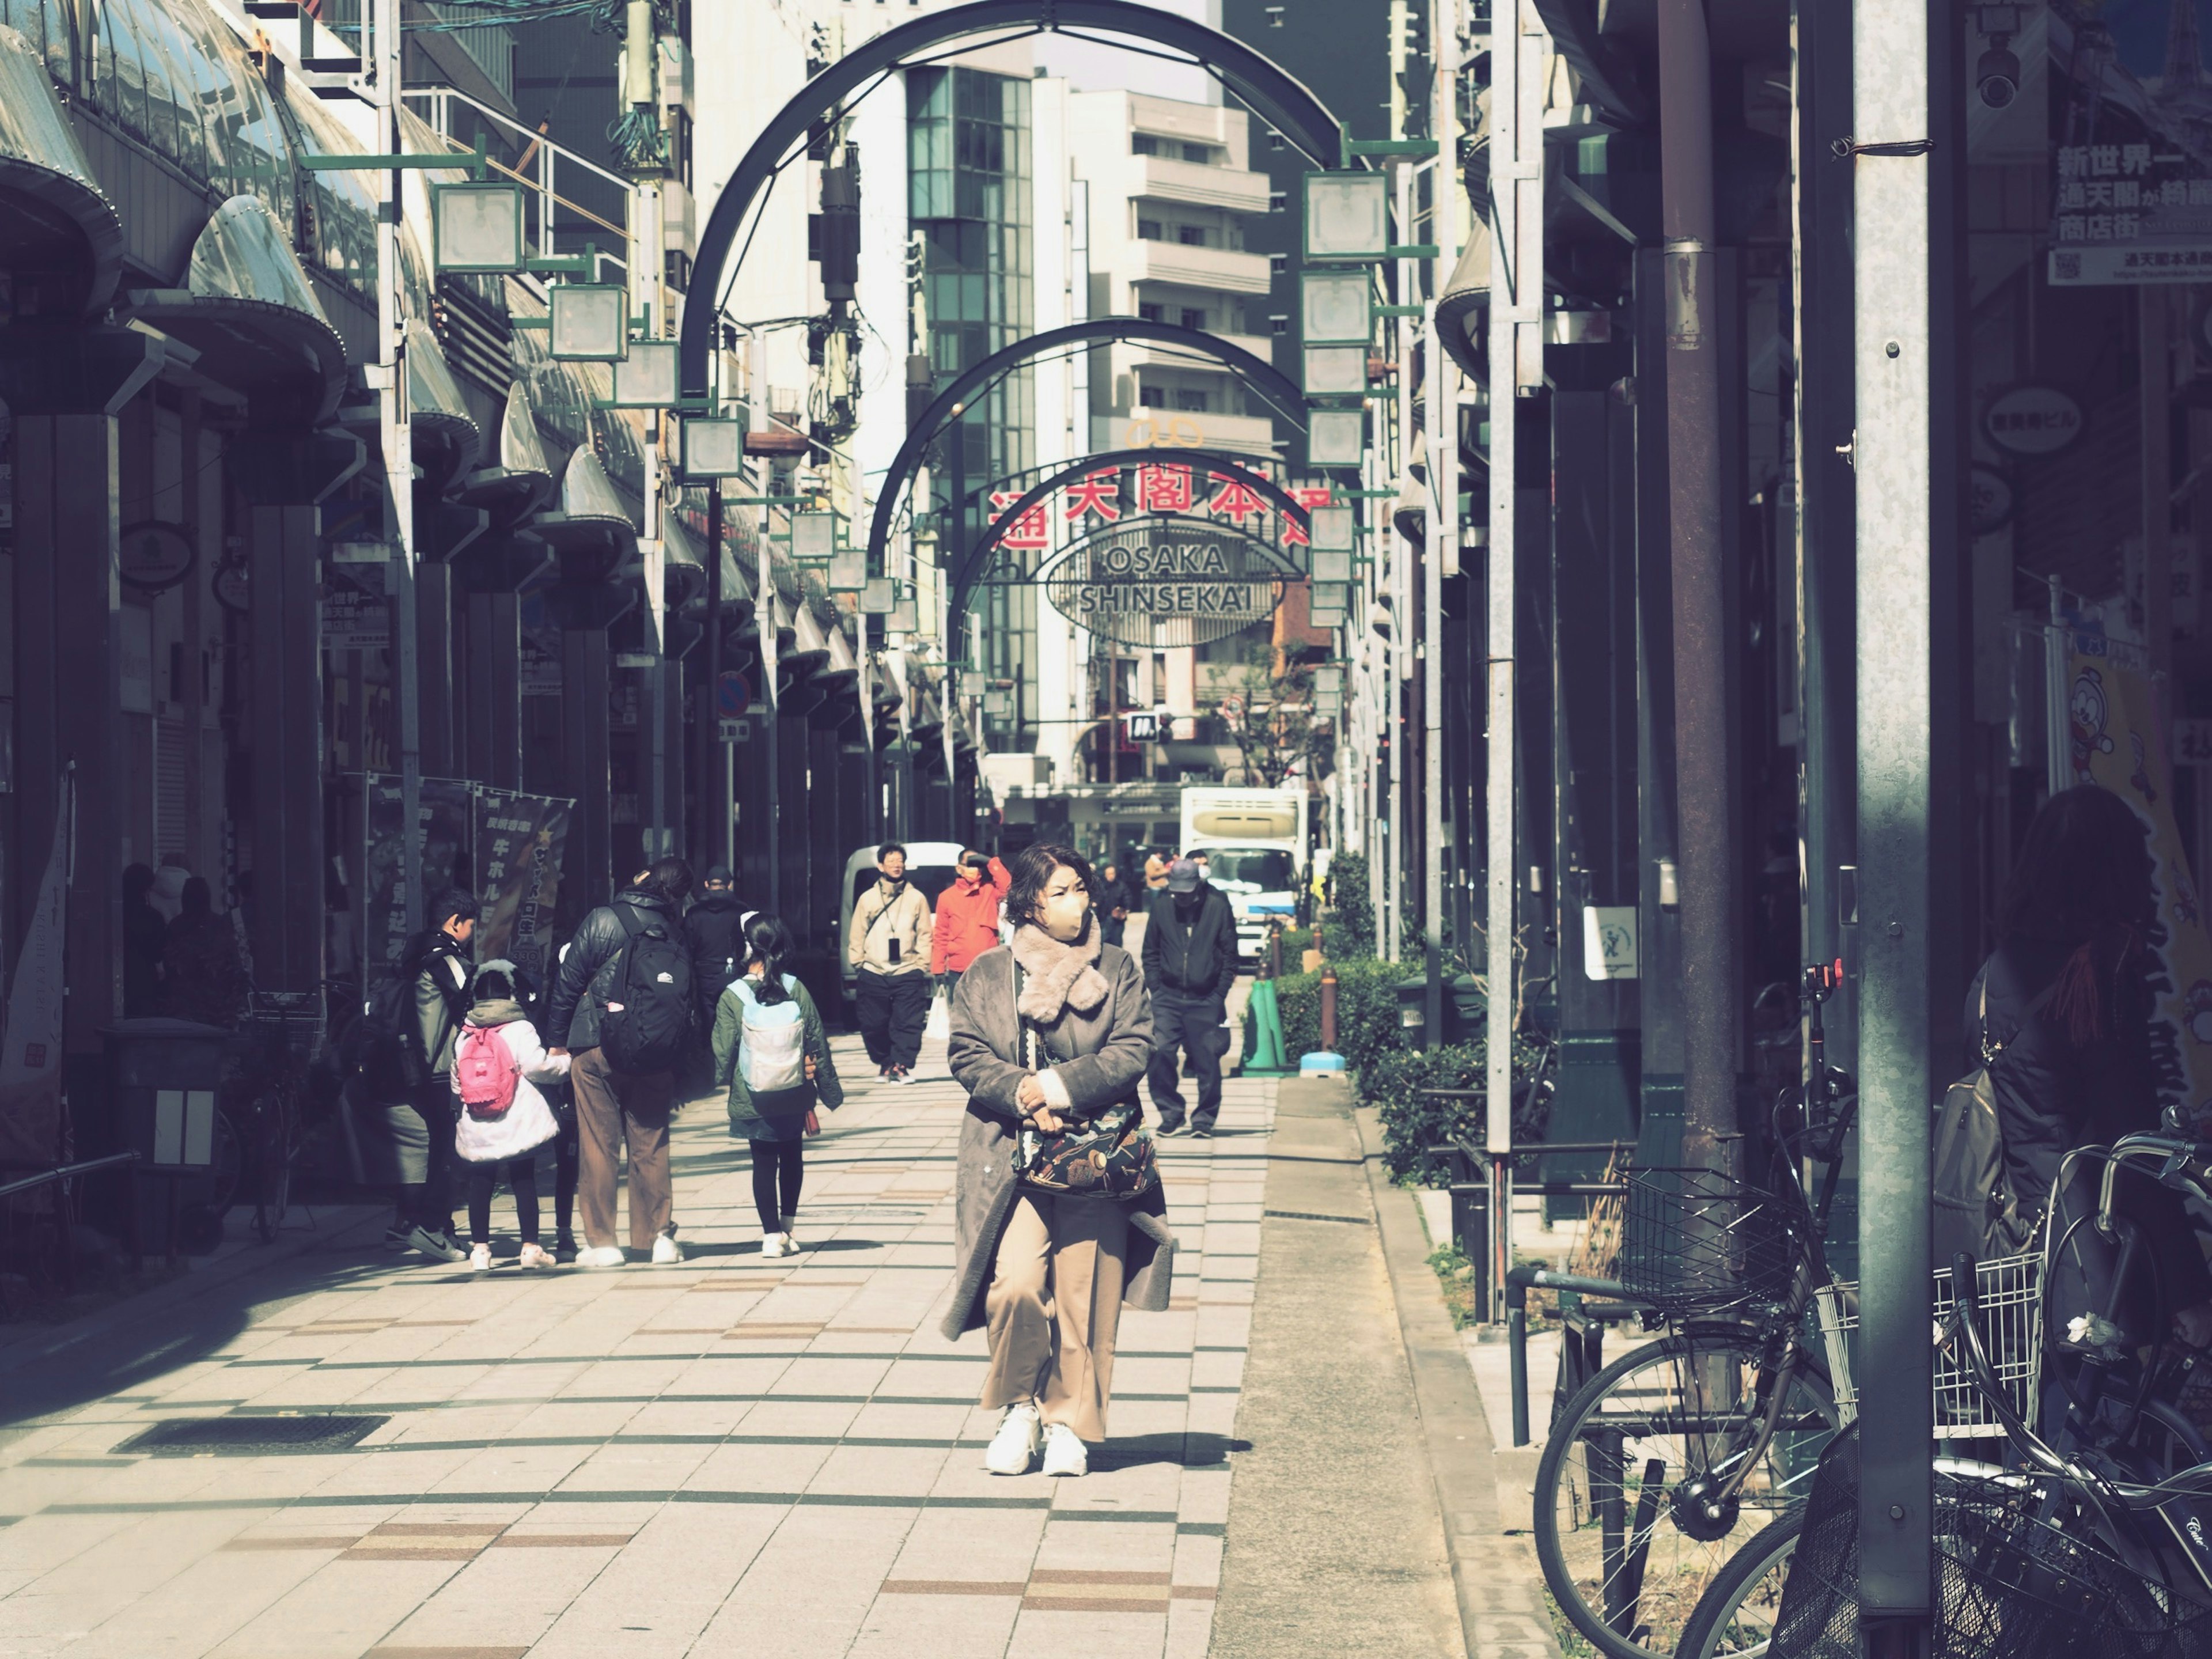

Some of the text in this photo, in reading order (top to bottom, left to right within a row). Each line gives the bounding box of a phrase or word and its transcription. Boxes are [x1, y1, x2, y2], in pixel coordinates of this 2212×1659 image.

[2058, 144, 2185, 176] 新世界一
[2059, 213, 2139, 241] 商店街
[1105, 544, 1228, 574] OSAKA
[1080, 586, 1253, 615] SHINSEKAI
